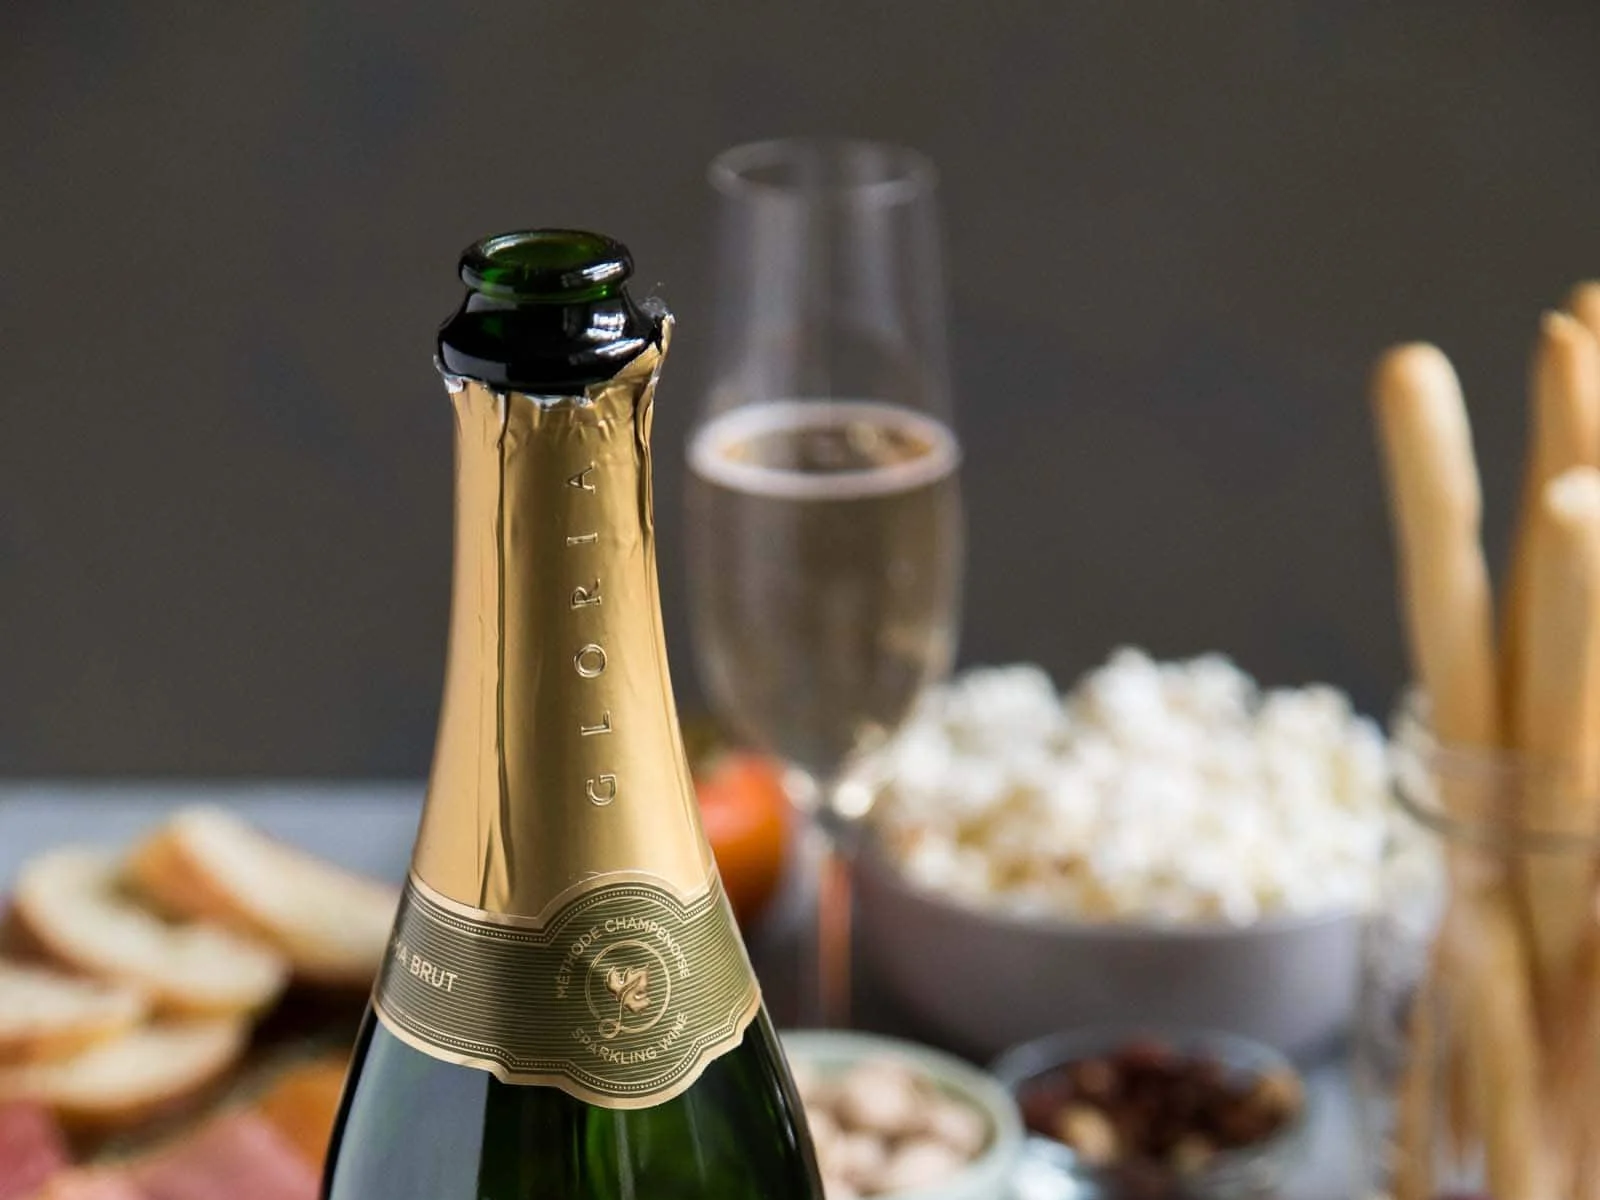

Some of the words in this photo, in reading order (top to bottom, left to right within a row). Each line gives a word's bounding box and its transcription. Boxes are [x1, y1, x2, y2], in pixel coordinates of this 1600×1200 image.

[567, 461, 617, 806] GLORIA
[410, 954, 458, 992] BRUT
[571, 1027, 657, 1065] SPARKLING
[658, 1011, 689, 1050] WINE
